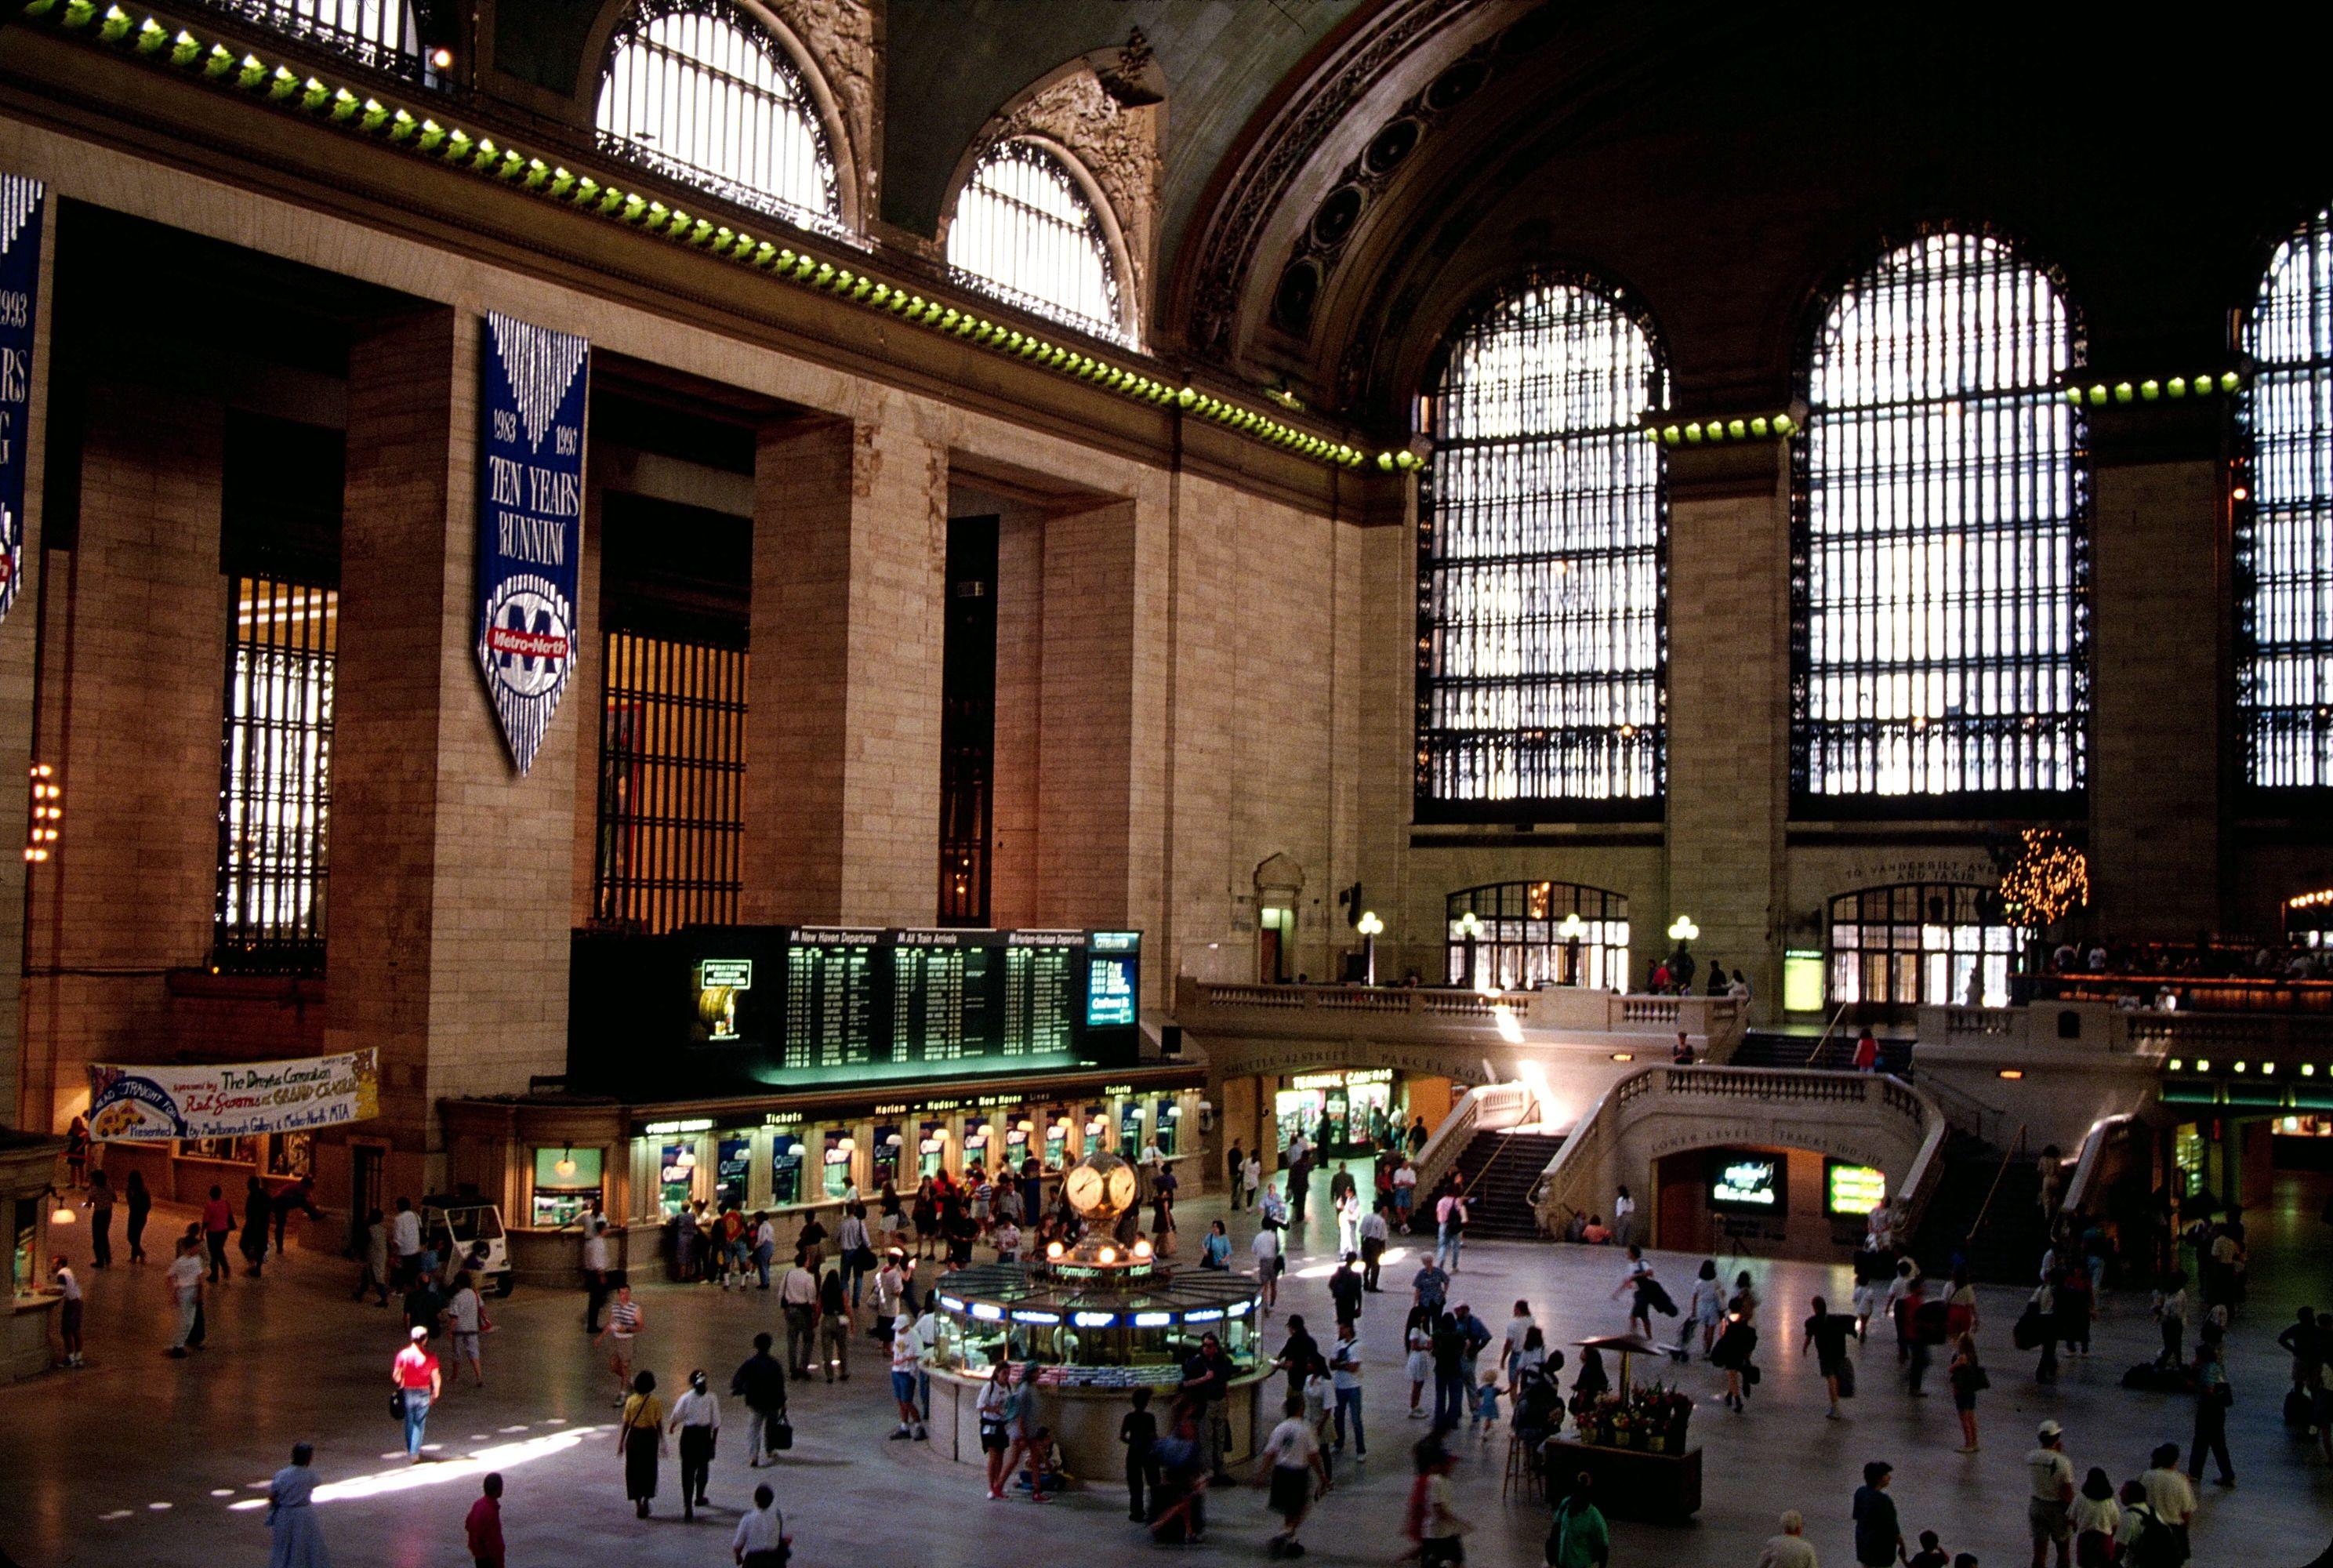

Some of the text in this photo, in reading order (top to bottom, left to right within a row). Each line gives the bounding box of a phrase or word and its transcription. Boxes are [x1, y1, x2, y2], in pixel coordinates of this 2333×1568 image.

[493, 408, 517, 443] 1983
[489, 455, 579, 517] TEN YEARS
[493, 630, 567, 655] Metro-North
[801, 931, 817, 943] New
[818, 931, 840, 943] Haven
[841, 931, 877, 946] Departures
[906, 932, 916, 944] All
[917, 932, 932, 944] Train
[934, 933, 957, 944] Arrivals
[1057, 934, 1085, 946] Departures
[1381, 1053, 1442, 1072] PARCEL
[221, 1070, 245, 1090] The
[1293, 1068, 1393, 1090] TERMINAL CAMERAS
[273, 1083, 314, 1105] GRAND
[1105, 1085, 1132, 1094] Tickets
[875, 1104, 907, 1115] Harlem
[927, 1100, 959, 1110] Hudson
[978, 1096, 996, 1106] New
[998, 1094, 1022, 1105] Haven
[130, 1121, 171, 1138] Presented
[330, 1102, 350, 1122] MTA
[765, 1112, 803, 1124] Tickets
